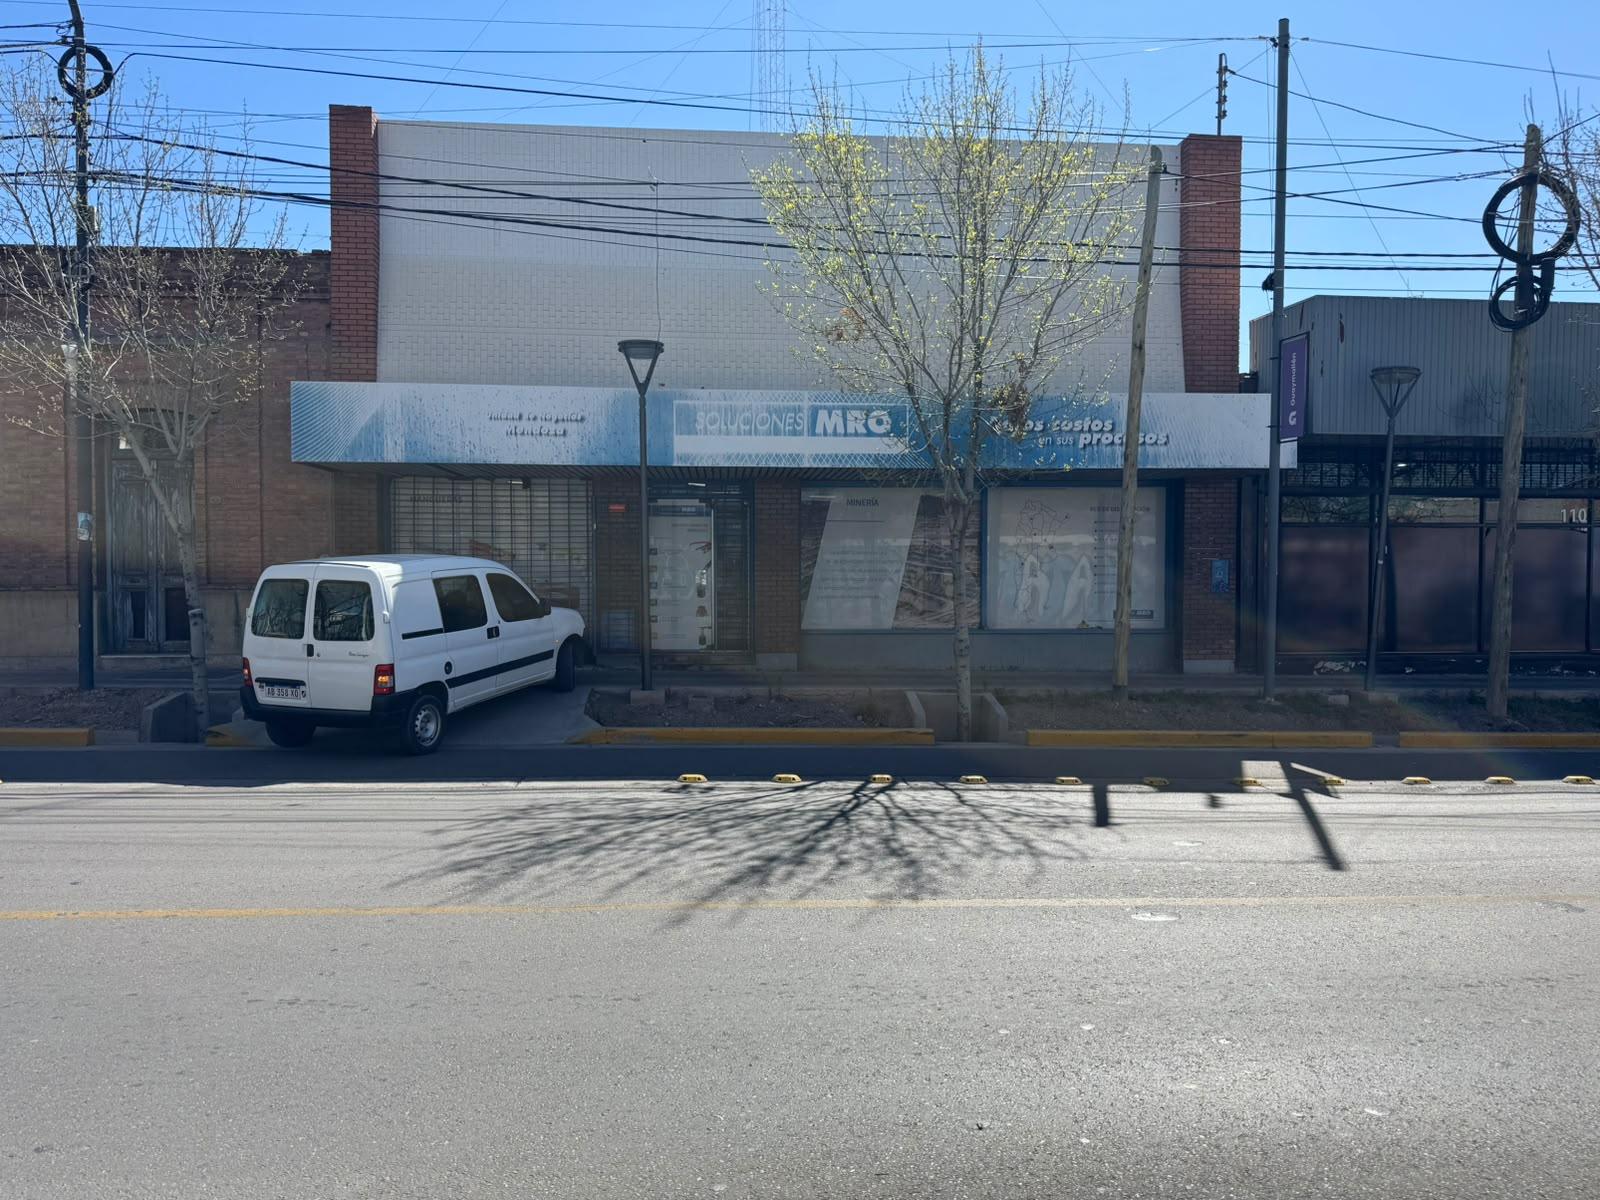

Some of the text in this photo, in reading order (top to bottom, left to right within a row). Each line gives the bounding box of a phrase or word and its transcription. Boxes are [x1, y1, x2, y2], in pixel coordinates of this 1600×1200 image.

[695, 409, 892, 434] SOLUCIONES MRO
[1051, 416, 1115, 432] costos
[1038, 432, 1169, 449] en sus procsos
[1560, 508, 1588, 523] 110
[267, 687, 276, 697] AB
[277, 688, 289, 697] 358
